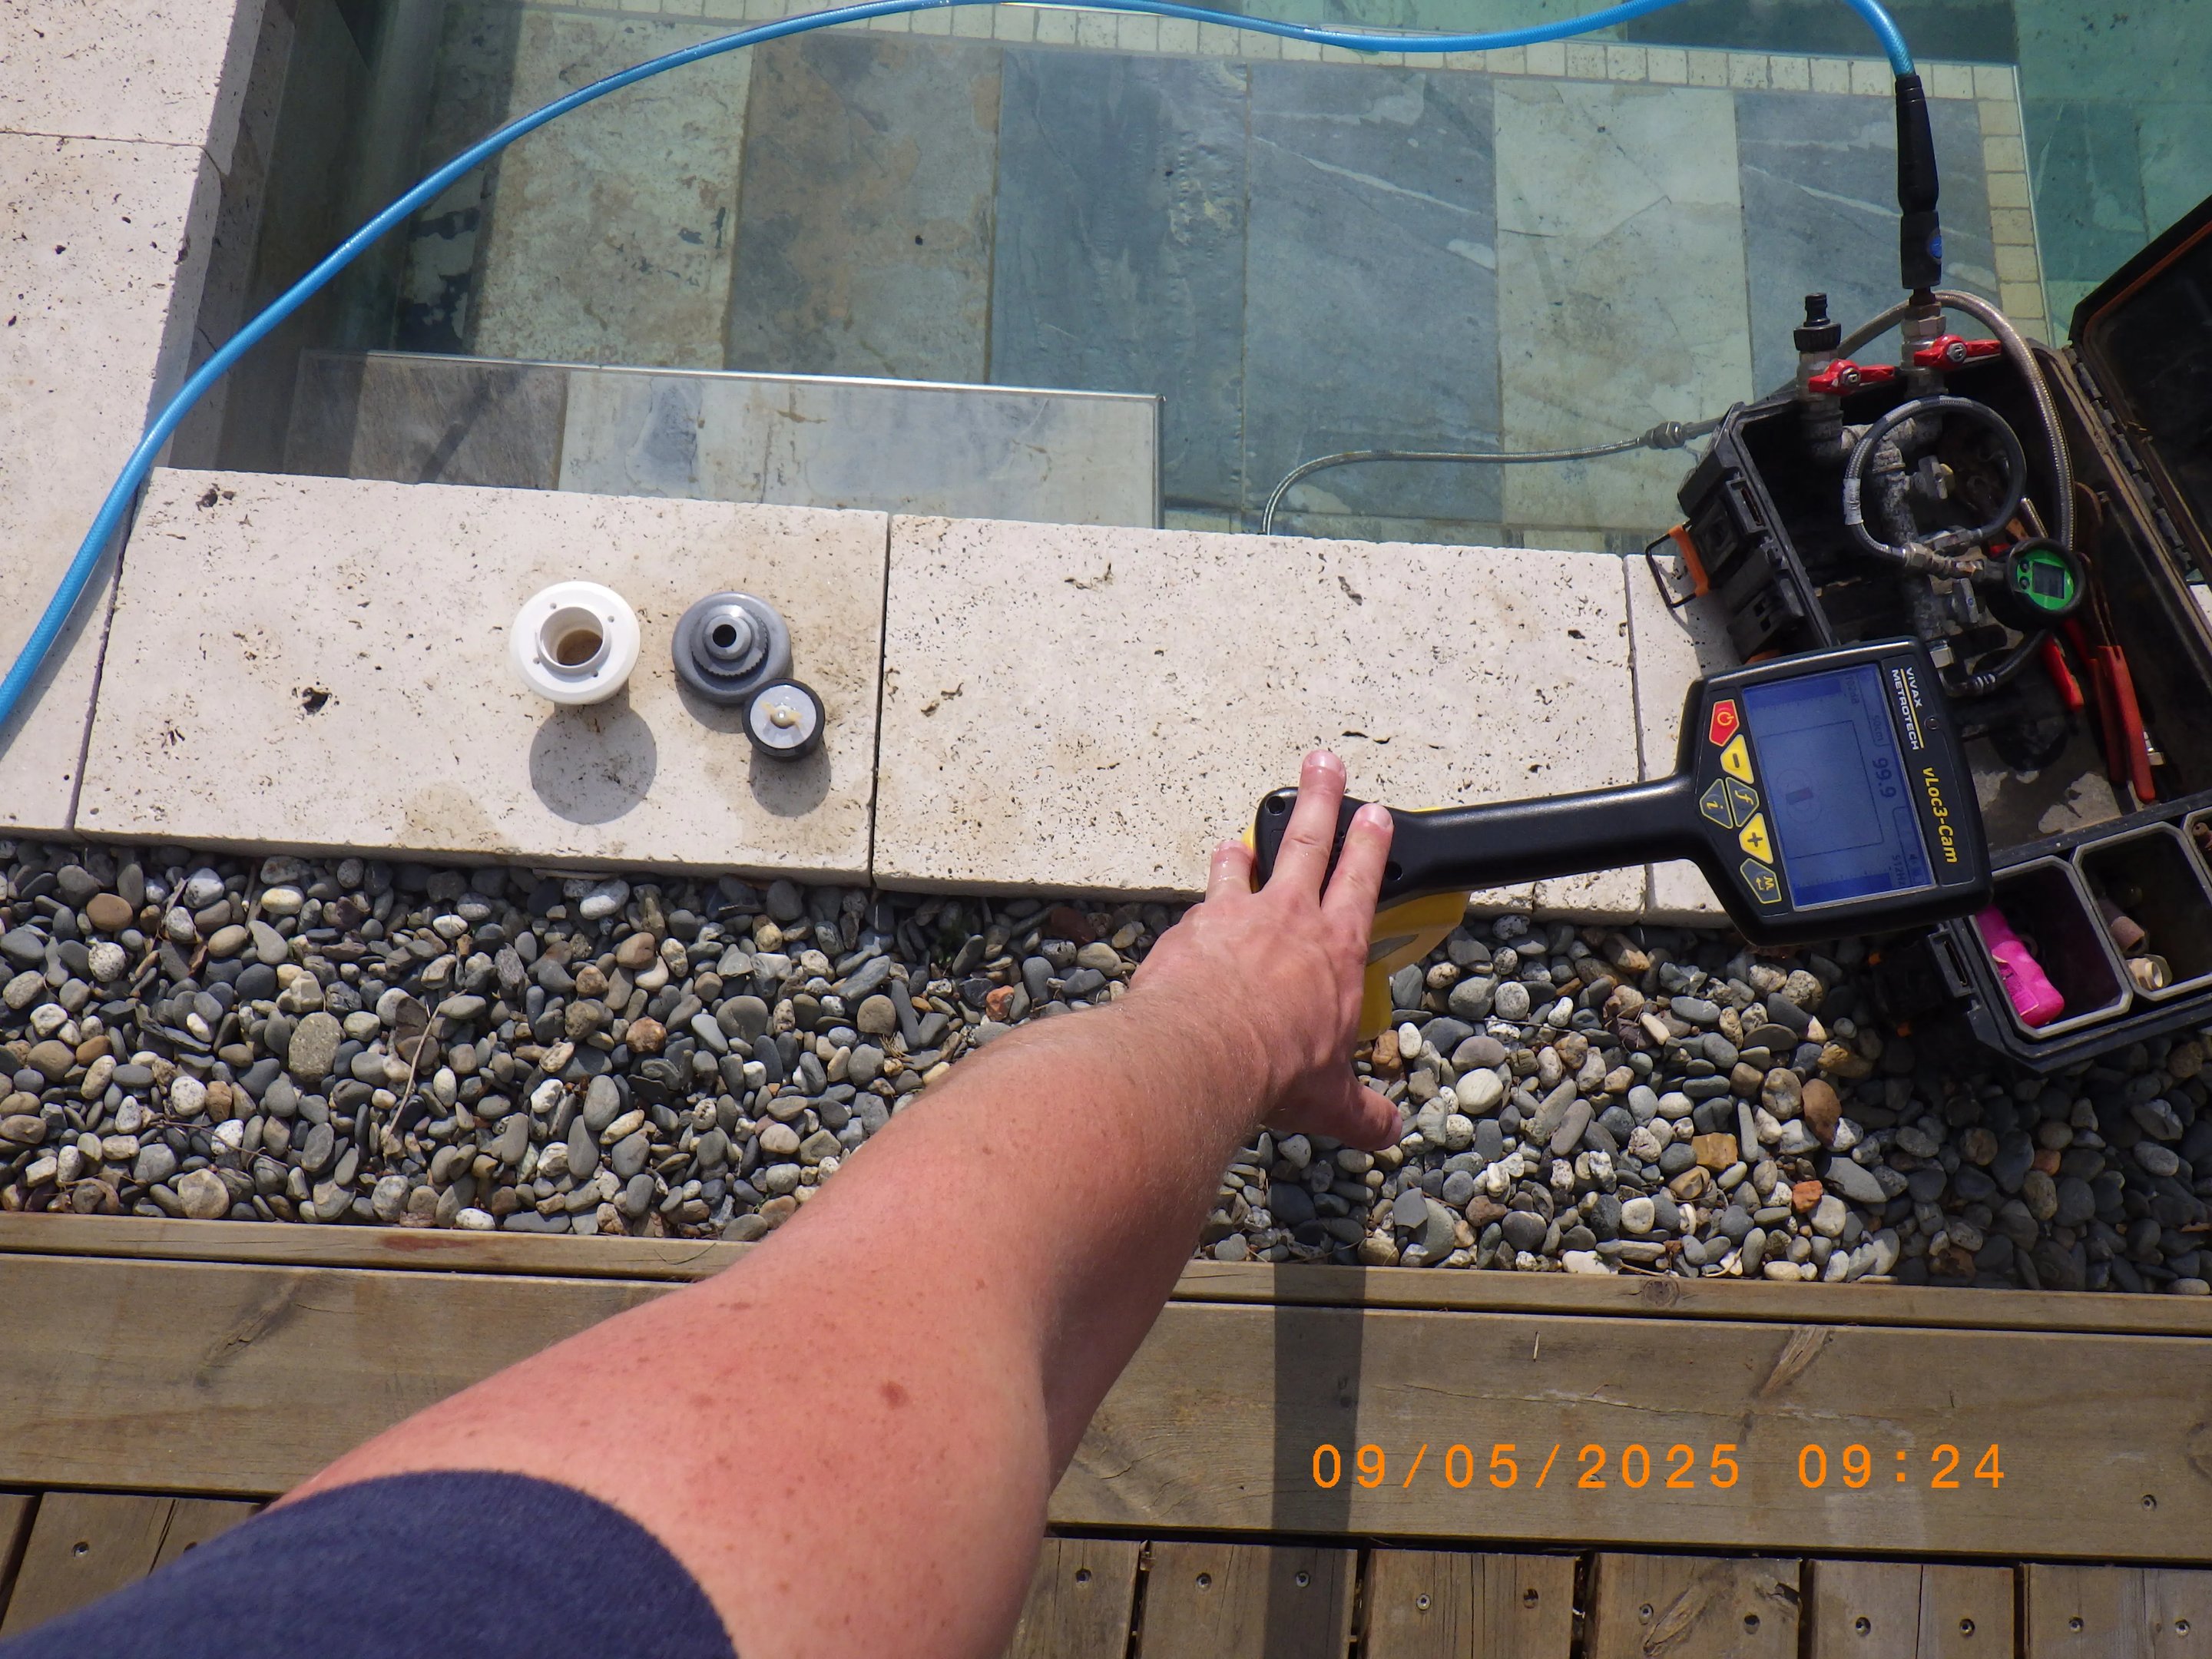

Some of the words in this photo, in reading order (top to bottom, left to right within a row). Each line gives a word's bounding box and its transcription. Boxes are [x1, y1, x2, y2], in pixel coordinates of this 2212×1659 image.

[1892, 669, 1919, 750] METROTECH
[1906, 667, 1922, 708] VIVAX
[1873, 757, 1896, 798] 99.9
[1922, 767, 1958, 863] vLoc3-Cam
